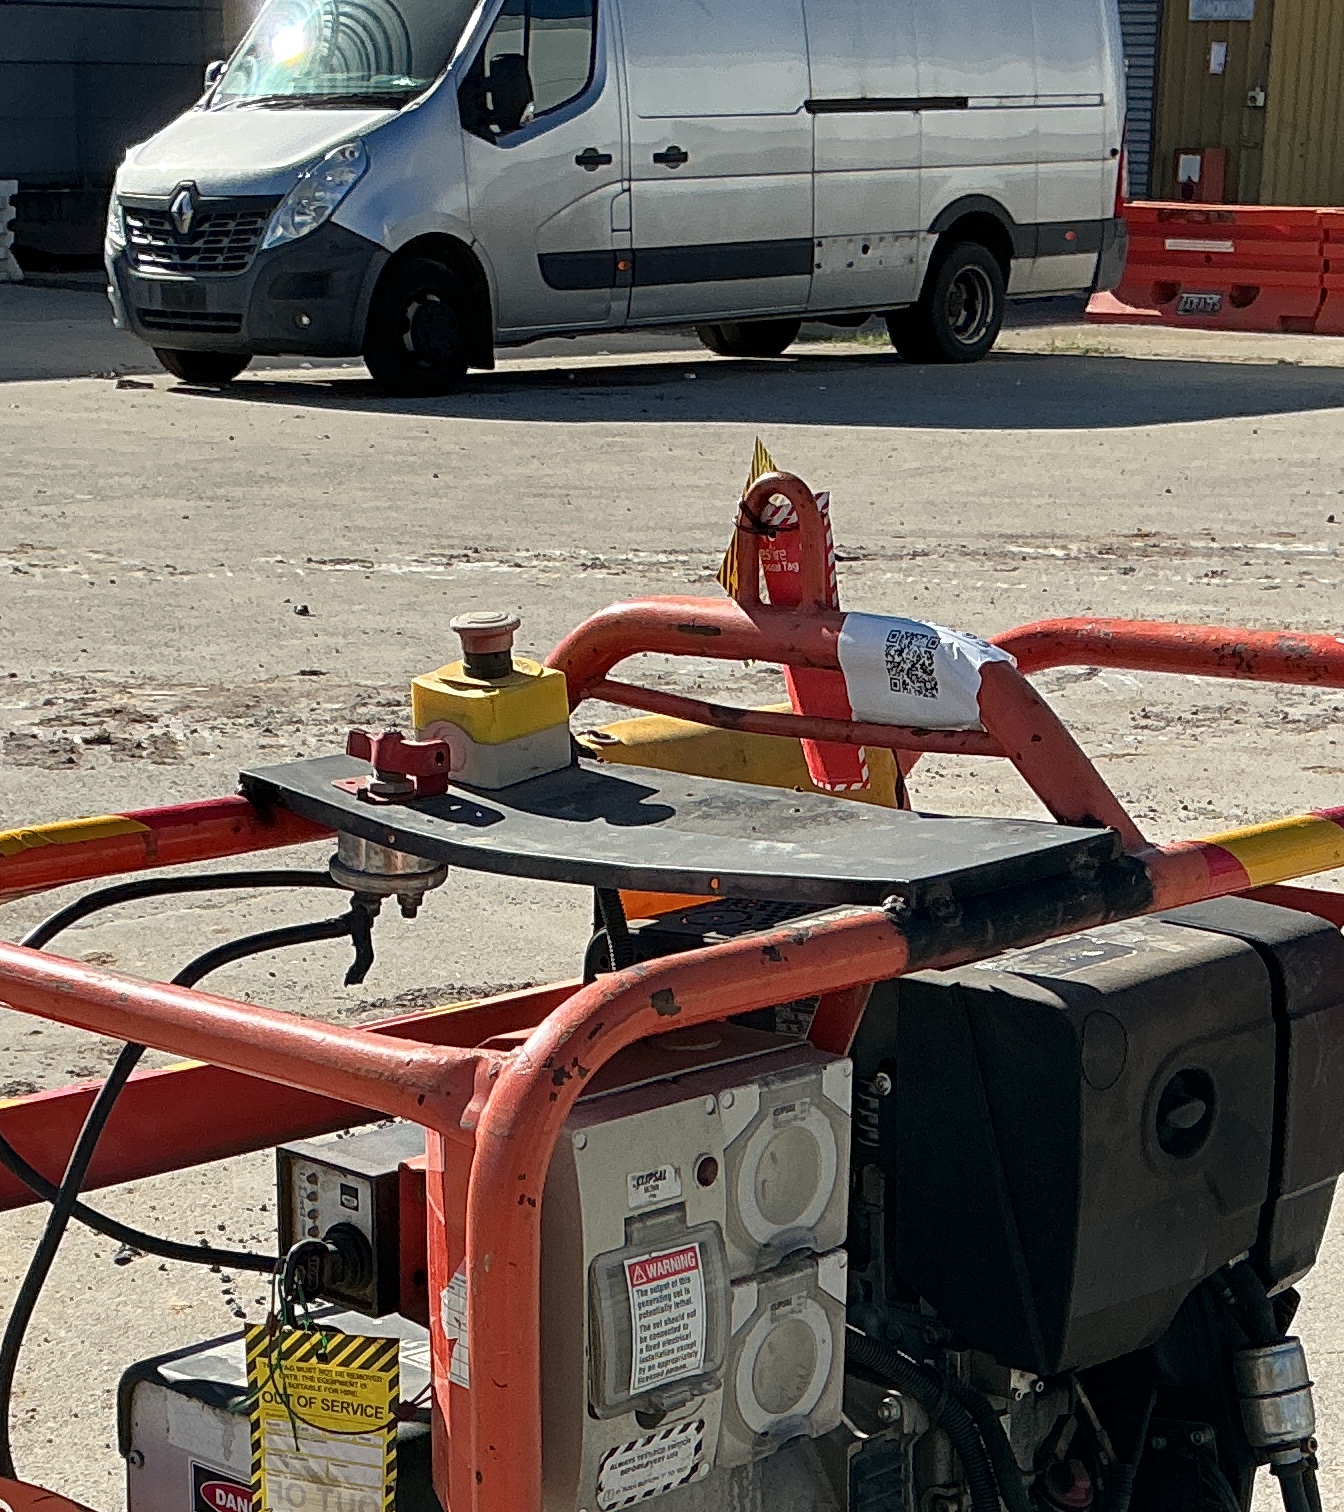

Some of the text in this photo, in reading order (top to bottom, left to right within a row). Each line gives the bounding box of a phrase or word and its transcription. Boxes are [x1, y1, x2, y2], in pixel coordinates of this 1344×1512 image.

[645, 1252, 696, 1279] WARNING
[262, 1391, 385, 1420] OUT OF SERVICE
